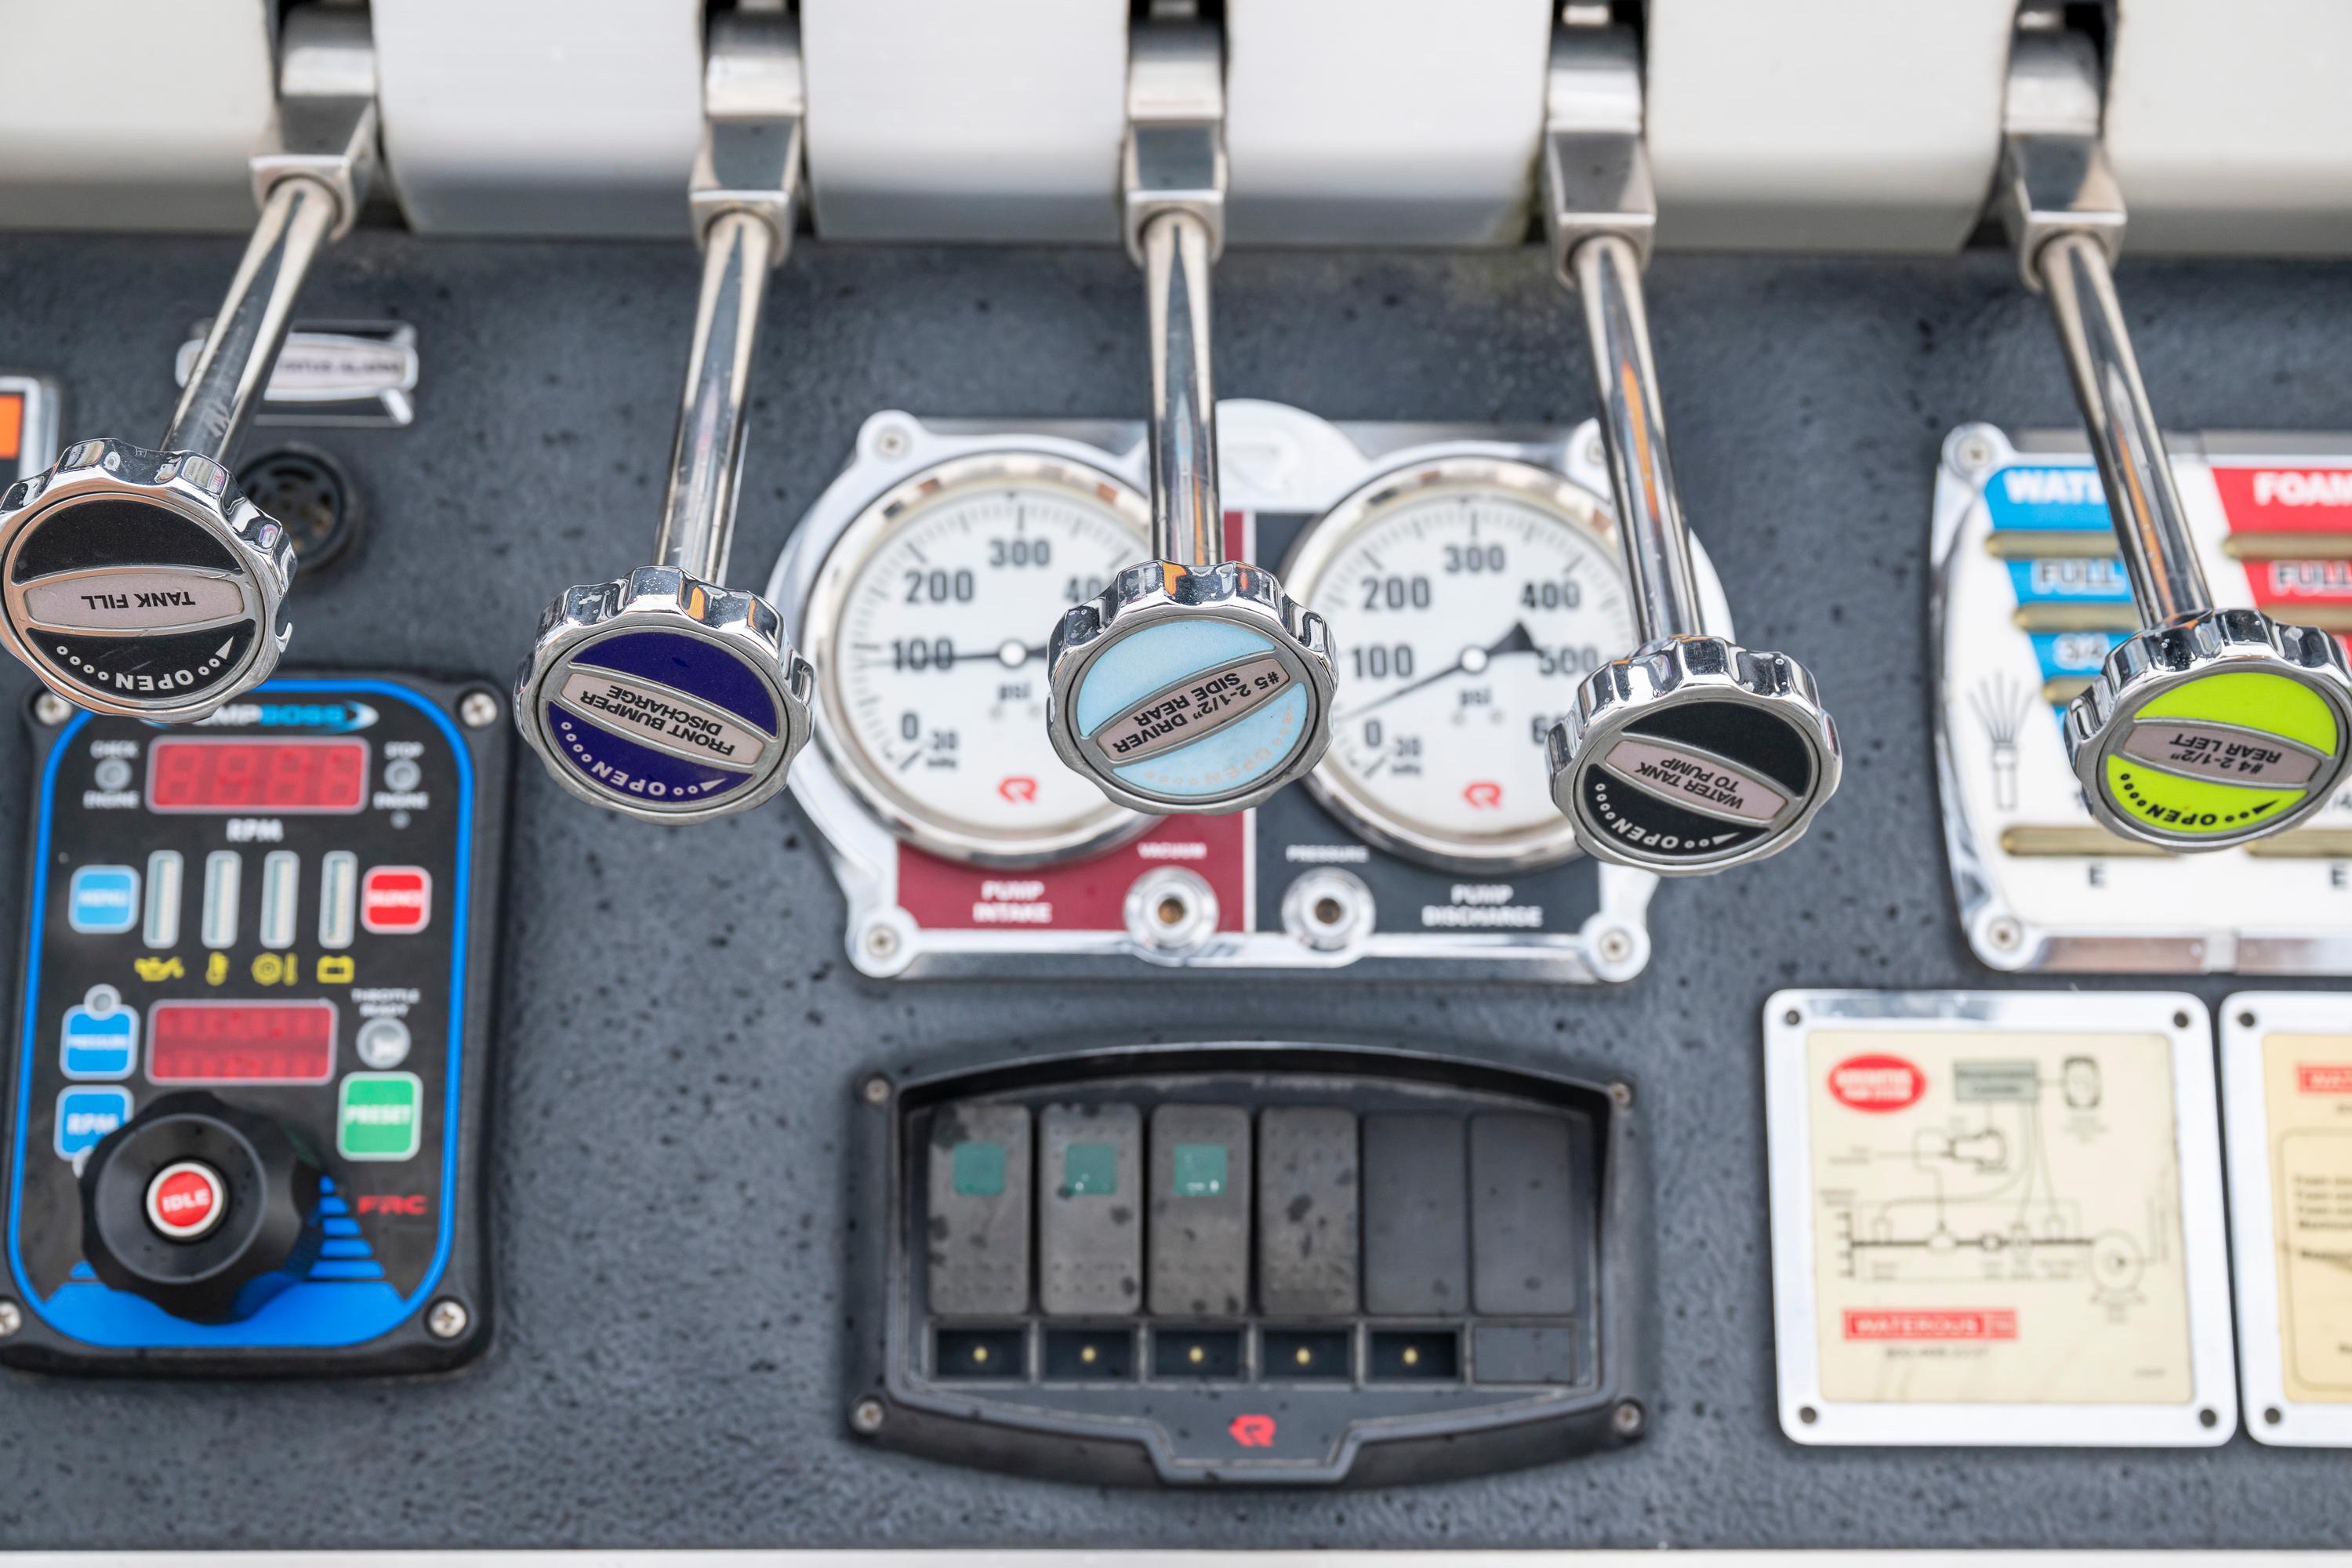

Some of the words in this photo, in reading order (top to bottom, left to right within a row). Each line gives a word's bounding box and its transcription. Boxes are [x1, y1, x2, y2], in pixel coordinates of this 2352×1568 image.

[988, 539, 1052, 568] 300
[1445, 545, 1506, 574] 300
[133, 591, 196, 608] TANK
[904, 570, 975, 604] 200
[1064, 575, 1104, 604] 40
[1360, 577, 1432, 611] 200
[1520, 582, 1581, 610] 400
[81, 593, 129, 610] FILL
[891, 639, 955, 672] 100
[1352, 646, 1415, 679] 100
[1538, 647, 1597, 676] 500
[115, 670, 194, 691] OPEN
[1191, 672, 1241, 702] SIDE
[1254, 671, 1279, 691] #5
[580, 690, 666, 731] BUMPER
[607, 684, 723, 736] DISCHARGE
[1133, 695, 1191, 728] REAR
[666, 722, 735, 757] FRONT
[901, 713, 919, 741] 0
[1112, 714, 1189, 753] DRIVER
[1364, 719, 1382, 747] 0
[2169, 733, 2222, 753] LEFT
[2224, 740, 2283, 764] REAR
[1660, 757, 1715, 786] PUMP
[2171, 752, 2236, 769] 2-1/2"
[2238, 760, 2264, 775] #4
[590, 760, 666, 797] OPEN
[1634, 761, 1686, 792] TANK
[1714, 775, 1740, 793] TO
[1685, 781, 1744, 810] WATER
[2145, 804, 2219, 826] OPEN
[227, 818, 283, 841] RPM
[1611, 817, 1679, 849] OPEN
[2089, 866, 2106, 886] E
[2331, 868, 2348, 887] E
[982, 880, 1044, 901] PUMP
[1450, 884, 1513, 904] PUMP
[973, 902, 1052, 923] INTAKE
[1421, 906, 1543, 927] DISCHARGE
[67, 1114, 118, 1135] RPM
[344, 1104, 412, 1124] PRESET
[162, 1188, 211, 1213] IDLE
